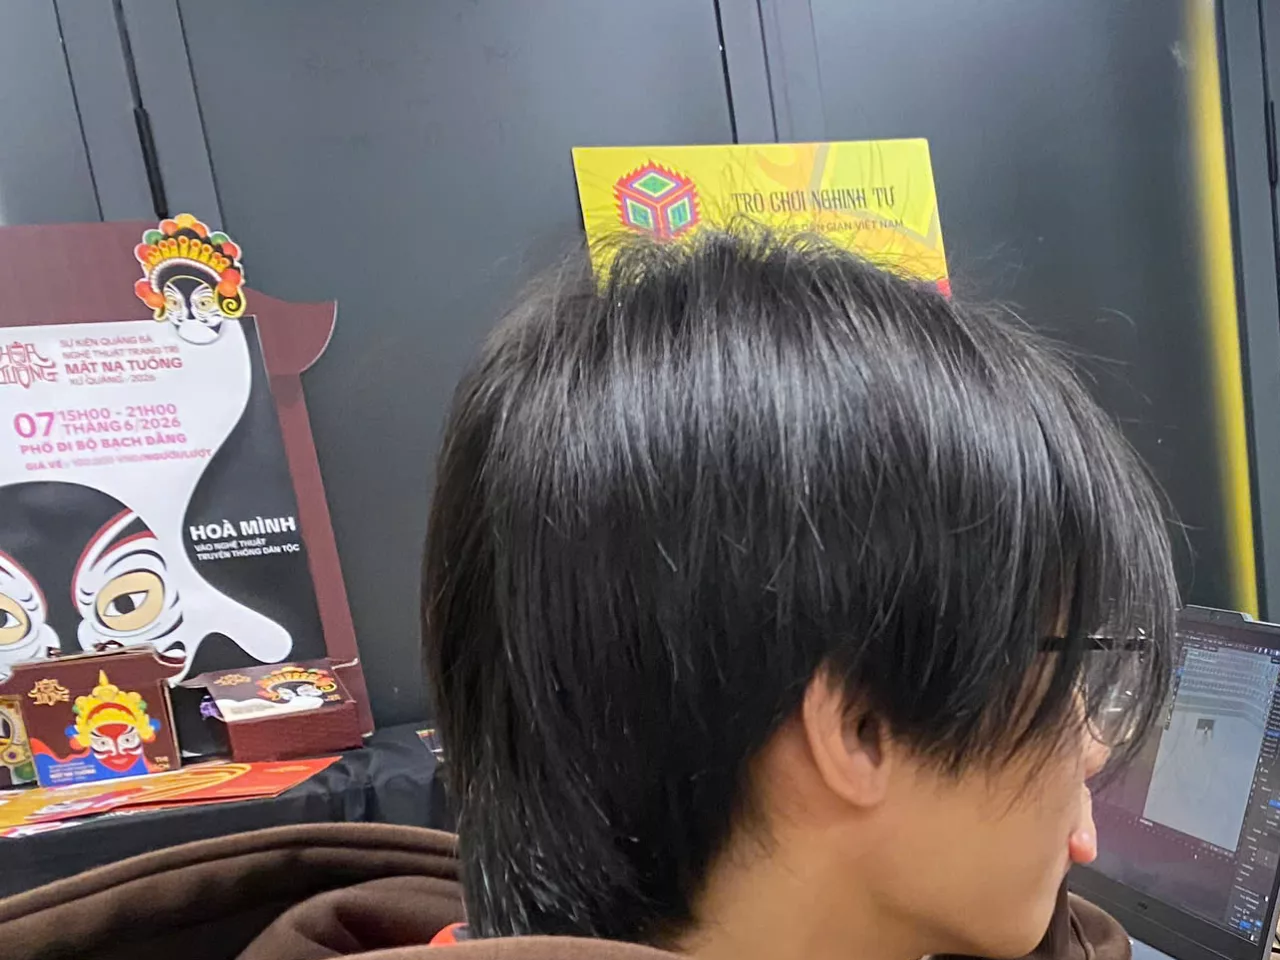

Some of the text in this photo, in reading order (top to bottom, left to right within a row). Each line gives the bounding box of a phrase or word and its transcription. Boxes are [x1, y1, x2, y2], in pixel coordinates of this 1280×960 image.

[59, 407, 111, 422] 15H00
[125, 403, 177, 419] 21H00
[14, 412, 55, 439] 07
[189, 516, 296, 541] HOÀ MÌNH
